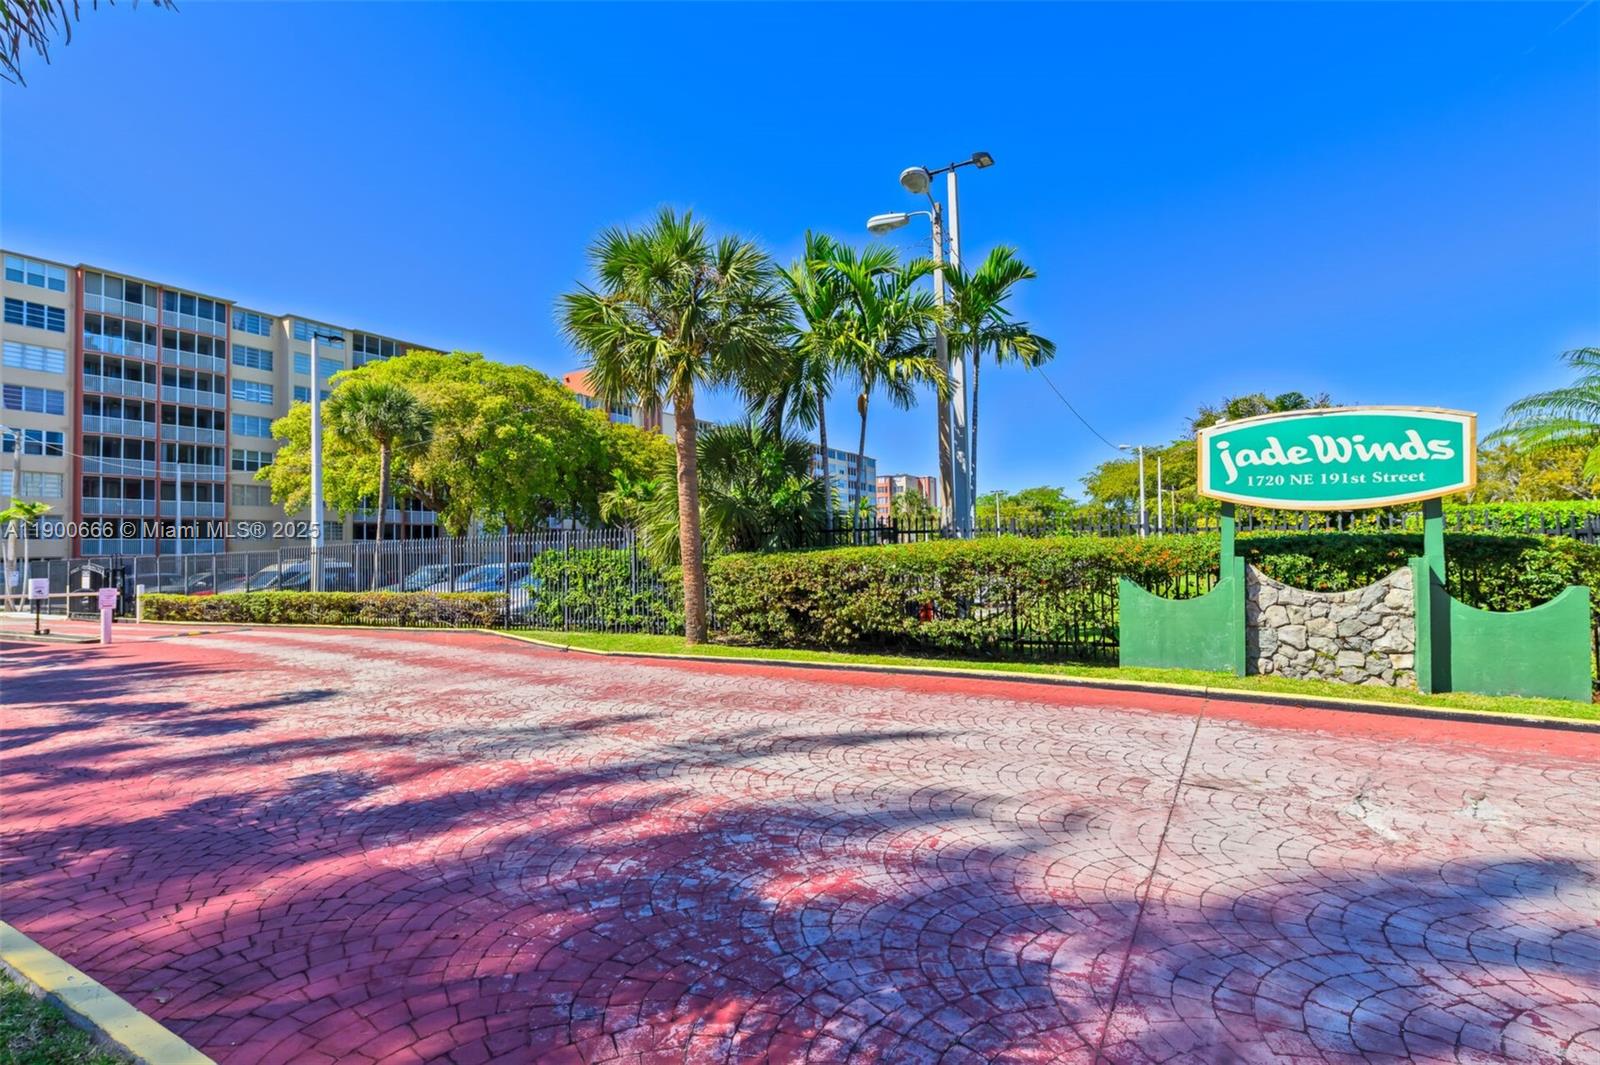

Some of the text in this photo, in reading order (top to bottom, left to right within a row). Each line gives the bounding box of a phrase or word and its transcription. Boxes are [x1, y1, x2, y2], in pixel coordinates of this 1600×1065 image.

[1216, 429, 1456, 485] jade Winds
[1247, 471, 1426, 487] 1720 NE 191st Street
